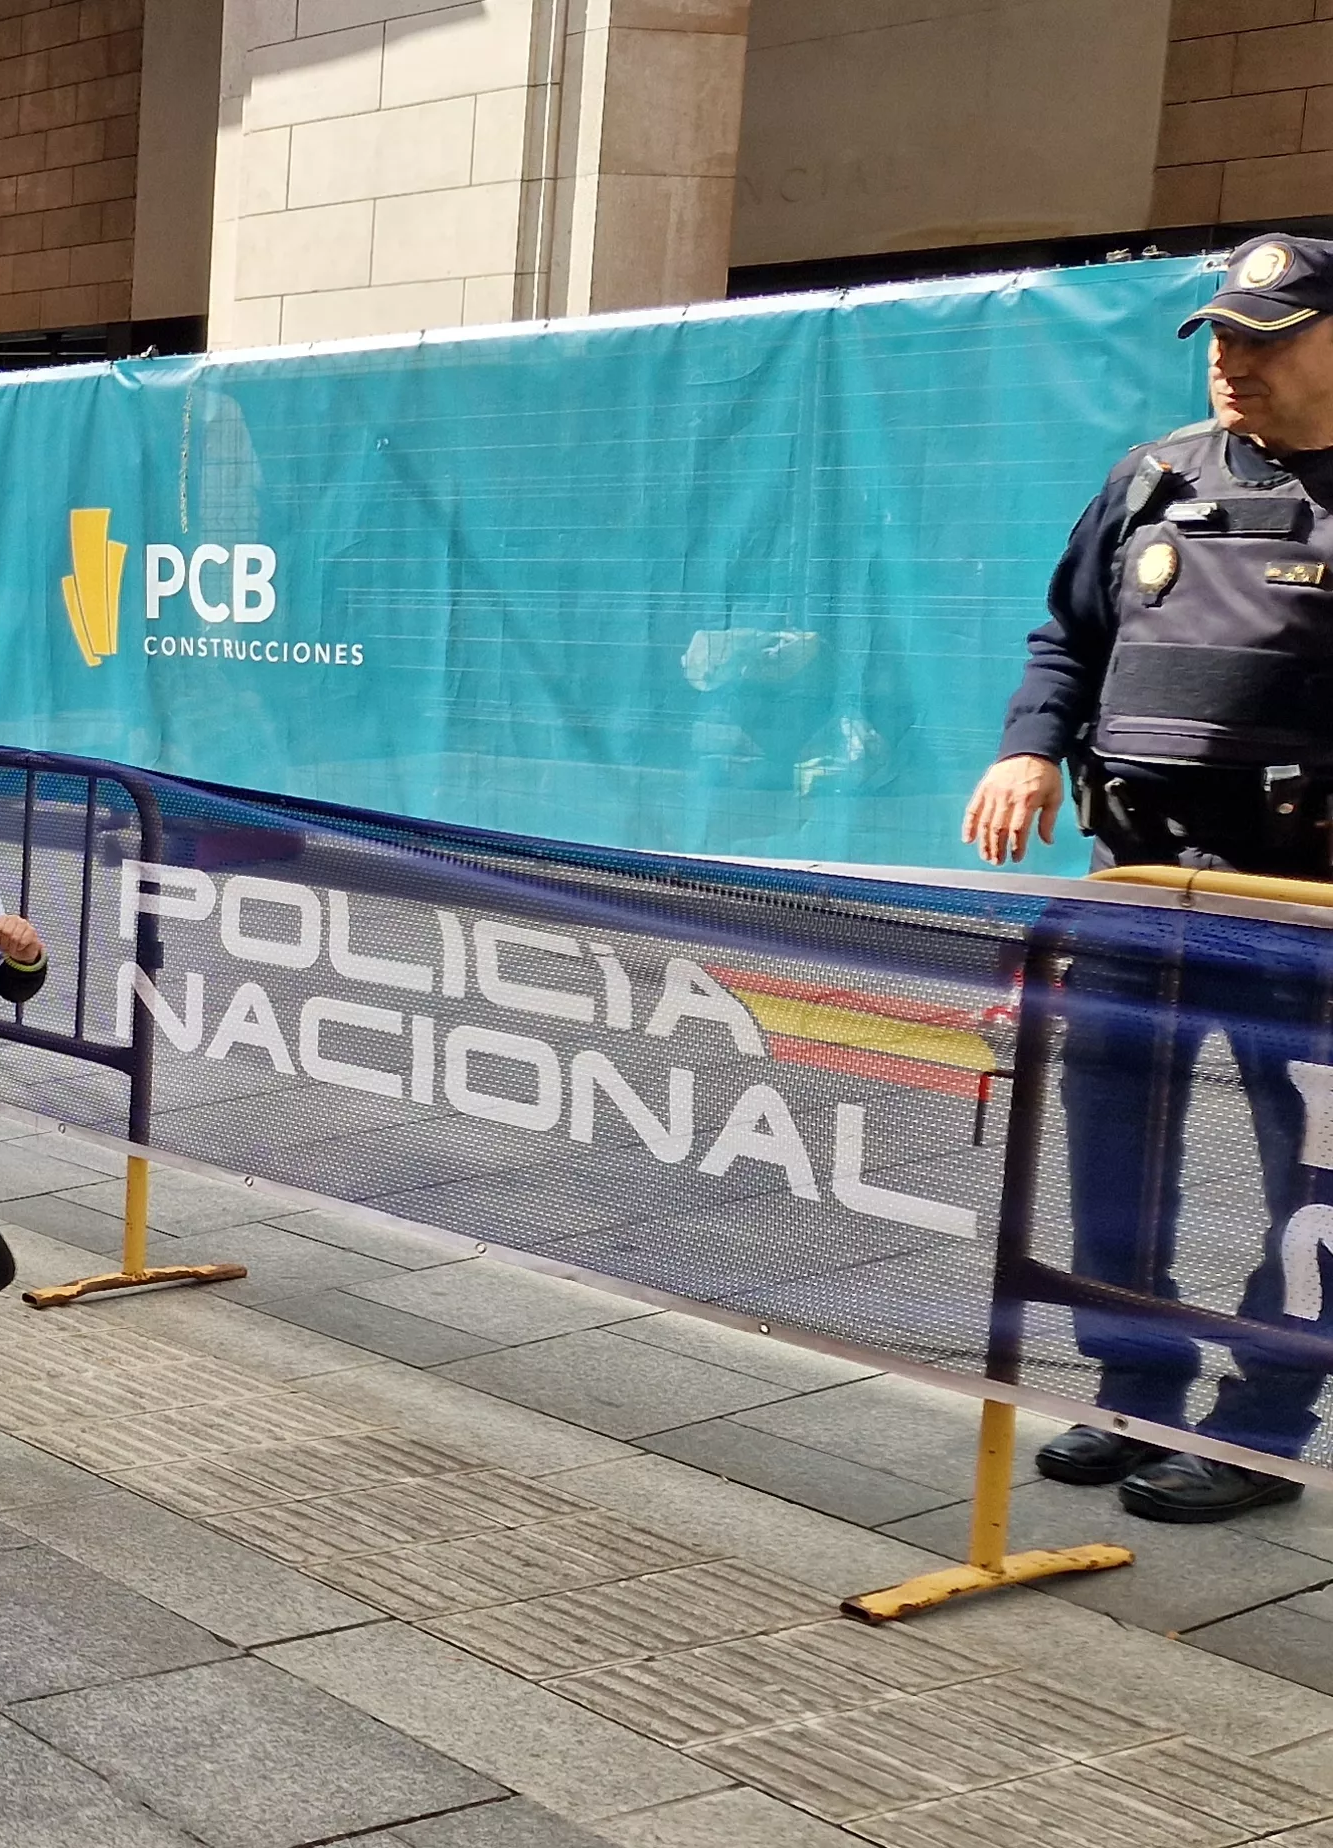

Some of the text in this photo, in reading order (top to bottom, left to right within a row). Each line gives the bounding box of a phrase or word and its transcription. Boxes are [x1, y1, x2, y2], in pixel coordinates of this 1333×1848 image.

[146, 544, 276, 623] PCB
[144, 636, 364, 666] CONSTRUCCIONES
[115, 961, 978, 1239] NACIONAL
